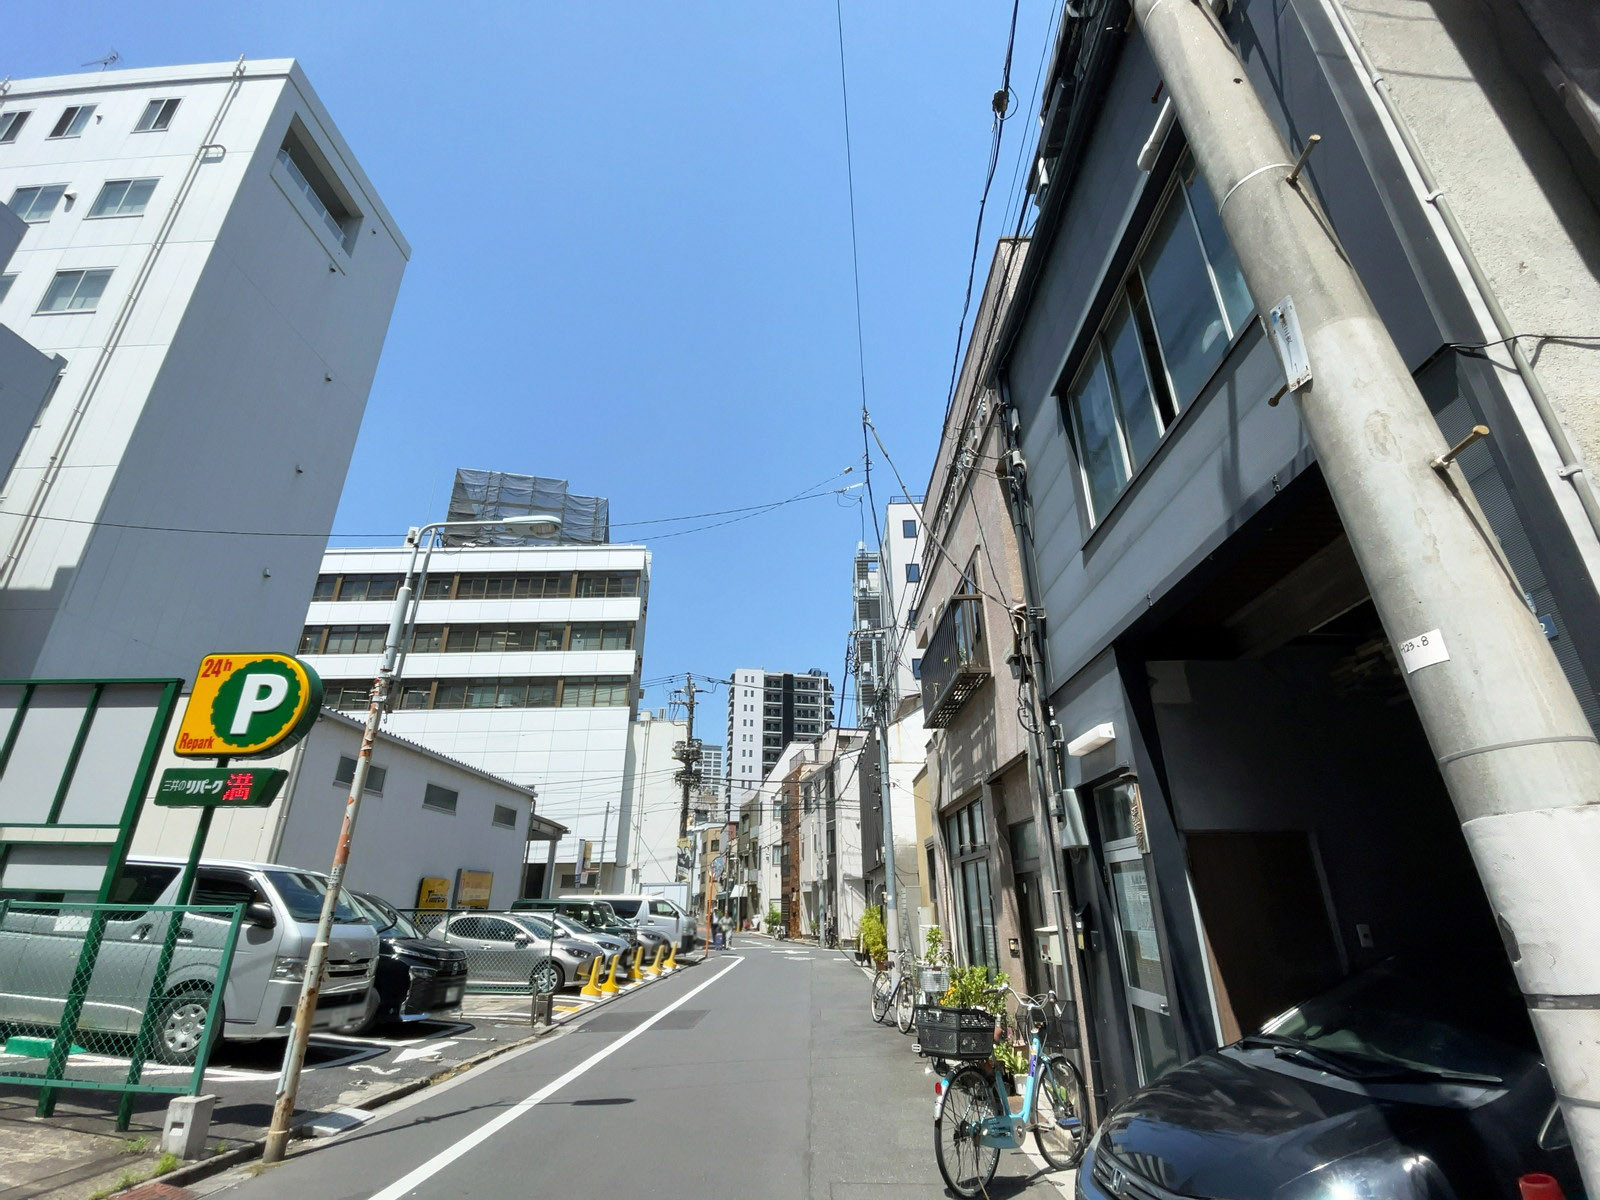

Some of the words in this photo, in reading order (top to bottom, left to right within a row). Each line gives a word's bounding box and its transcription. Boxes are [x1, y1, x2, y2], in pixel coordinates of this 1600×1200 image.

[229, 673, 289, 735] P
[179, 732, 215, 751] Repark
[162, 780, 224, 795] 三井のリパーク
[222, 773, 253, 801] 満
